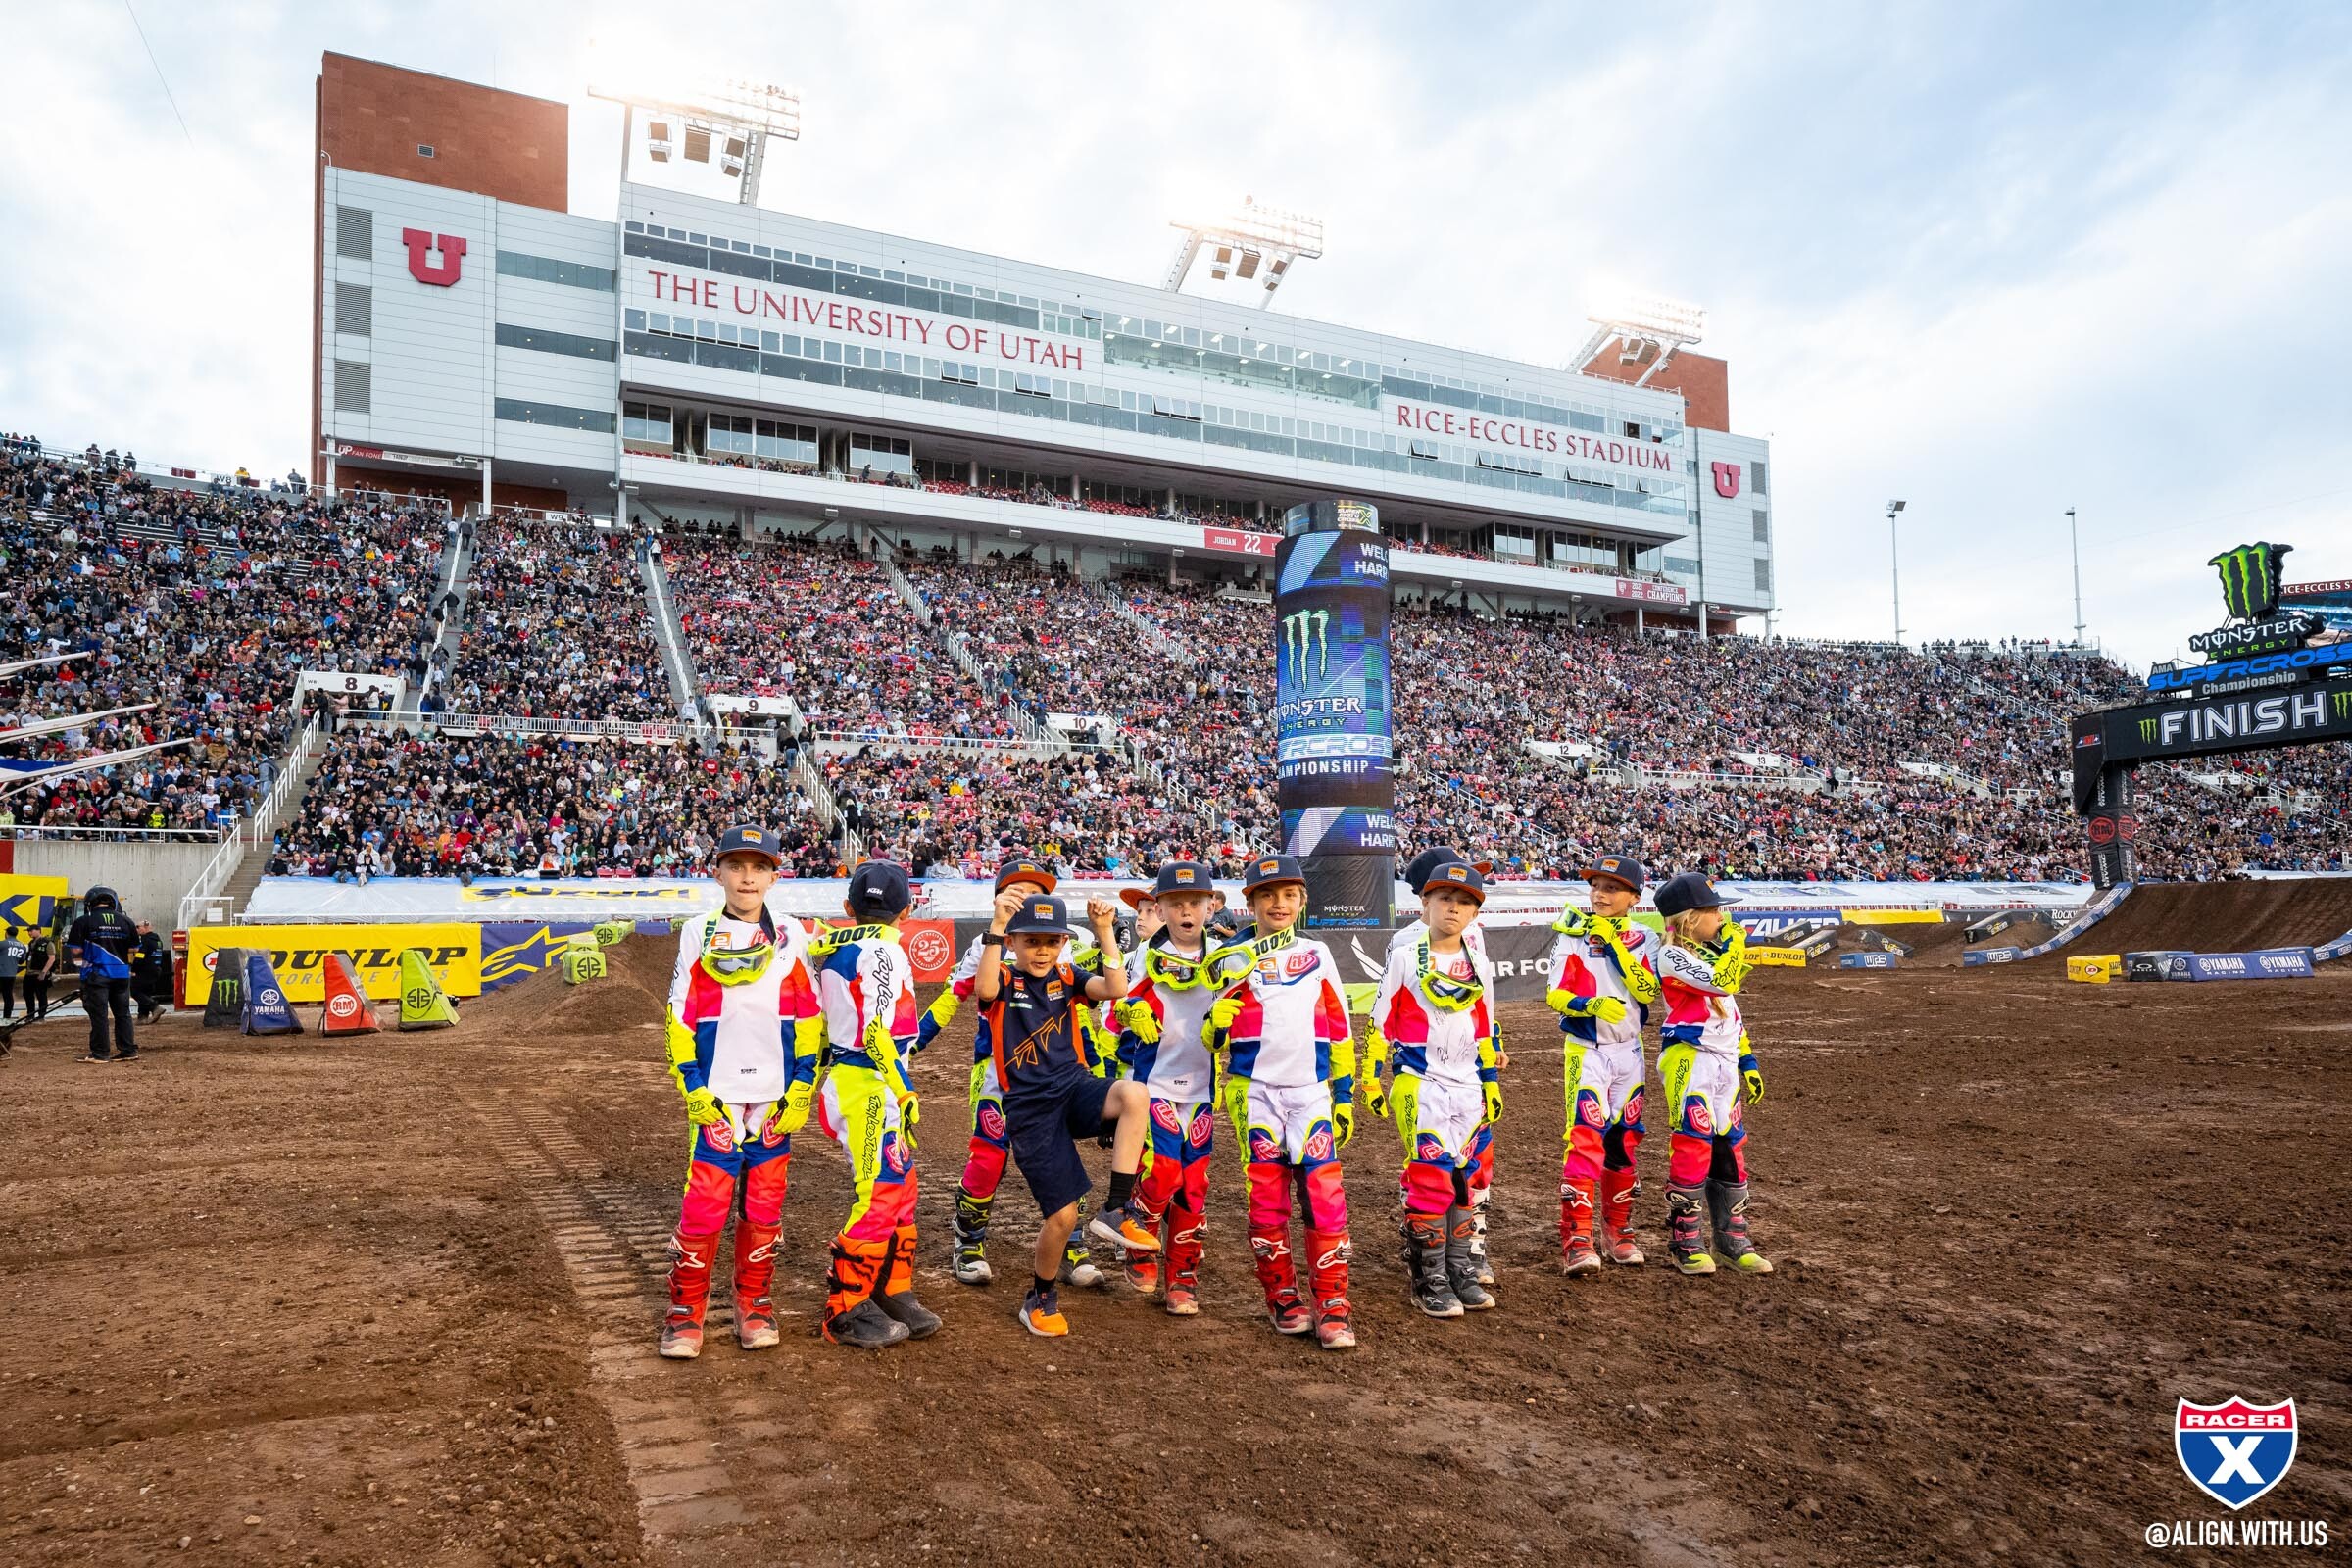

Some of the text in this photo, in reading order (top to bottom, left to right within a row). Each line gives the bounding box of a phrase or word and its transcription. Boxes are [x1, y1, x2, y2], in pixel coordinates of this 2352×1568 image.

[648, 270, 1082, 370] THE UNIVERSITY OF UTAH
[1397, 404, 1671, 471] RICE-ECCLES STADIUM
[1213, 534, 1261, 553] JORDAN 22
[1647, 590, 1685, 603] CHAMPIONS
[2281, 581, 2341, 594] ICE-ECCLES
[2190, 617, 2307, 652] MONSTER
[2210, 639, 2288, 659] ENERGY
[2148, 642, 2352, 691] SUPERCROSS
[2152, 665, 2173, 674] AMA
[345, 677, 358, 691] 8
[2202, 671, 2297, 695] Championship
[748, 699, 760, 711] 9
[1278, 697, 1363, 720] ONSTER
[1073, 717, 1087, 729] 10
[2161, 691, 2328, 746] FINISH
[1559, 745, 1569, 755] 12
[1756, 756, 1766, 765] 13
[1277, 760, 1368, 780] AMPIONSHIP
[2051, 908, 2078, 919] ROCKY
[828, 926, 883, 945] 100%
[1252, 929, 1291, 956] 100%
[7, 947, 24, 957] 102
[917, 939, 941, 956] 25
[1770, 952, 1805, 960] DUNLOP
[1417, 941, 1429, 979] 100%
[1665, 949, 1690, 972] Troy
[1864, 955, 1887, 967] WPS
[1986, 951, 2013, 963] WPS
[2211, 957, 2245, 970] YAMAHA
[2270, 956, 2305, 968] YAMAHA
[872, 947, 893, 988] Troy
[254, 1005, 285, 1014] YAMAHA
[864, 1095, 882, 1117] Troy
[865, 1117, 879, 1137] Lee
